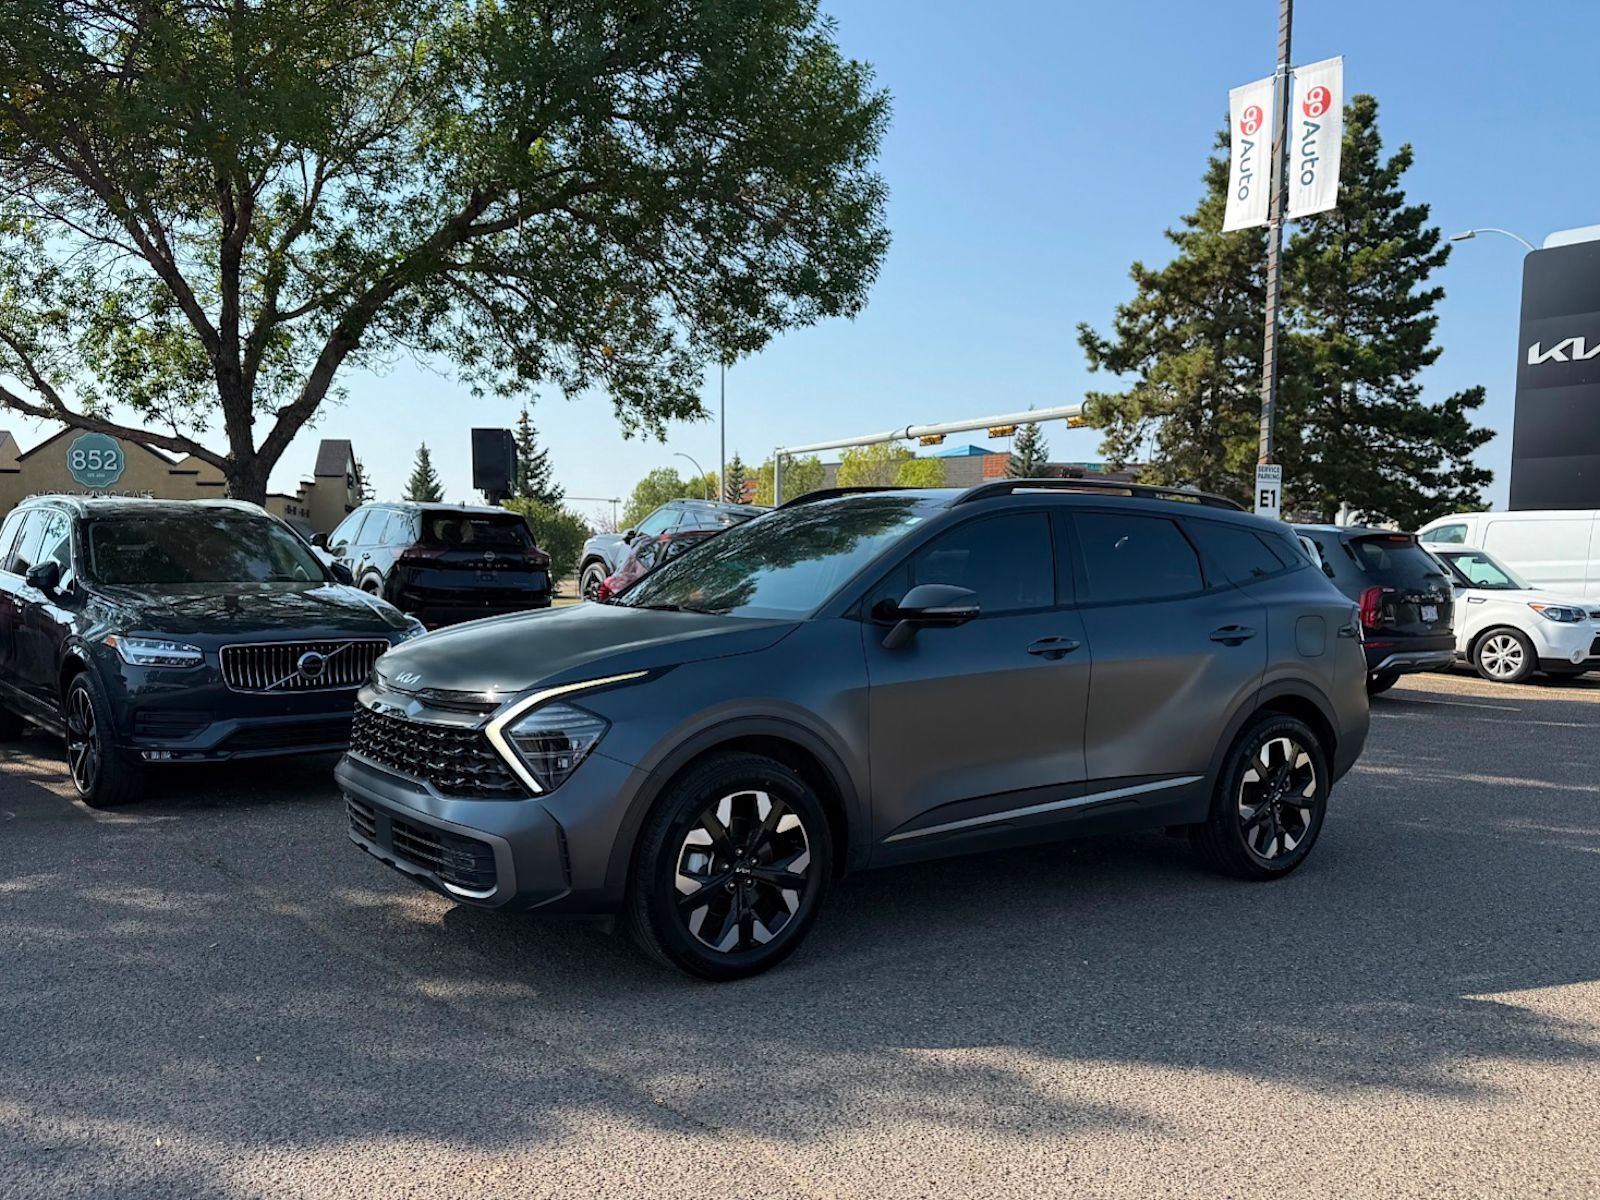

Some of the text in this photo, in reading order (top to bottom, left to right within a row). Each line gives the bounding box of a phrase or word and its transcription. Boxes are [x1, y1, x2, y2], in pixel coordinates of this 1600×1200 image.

[1300, 120, 1321, 187] Auto
[1237, 138, 1254, 202] Auto
[72, 449, 117, 471] 852
[1259, 489, 1276, 508] E1
[395, 671, 422, 684] KIA
